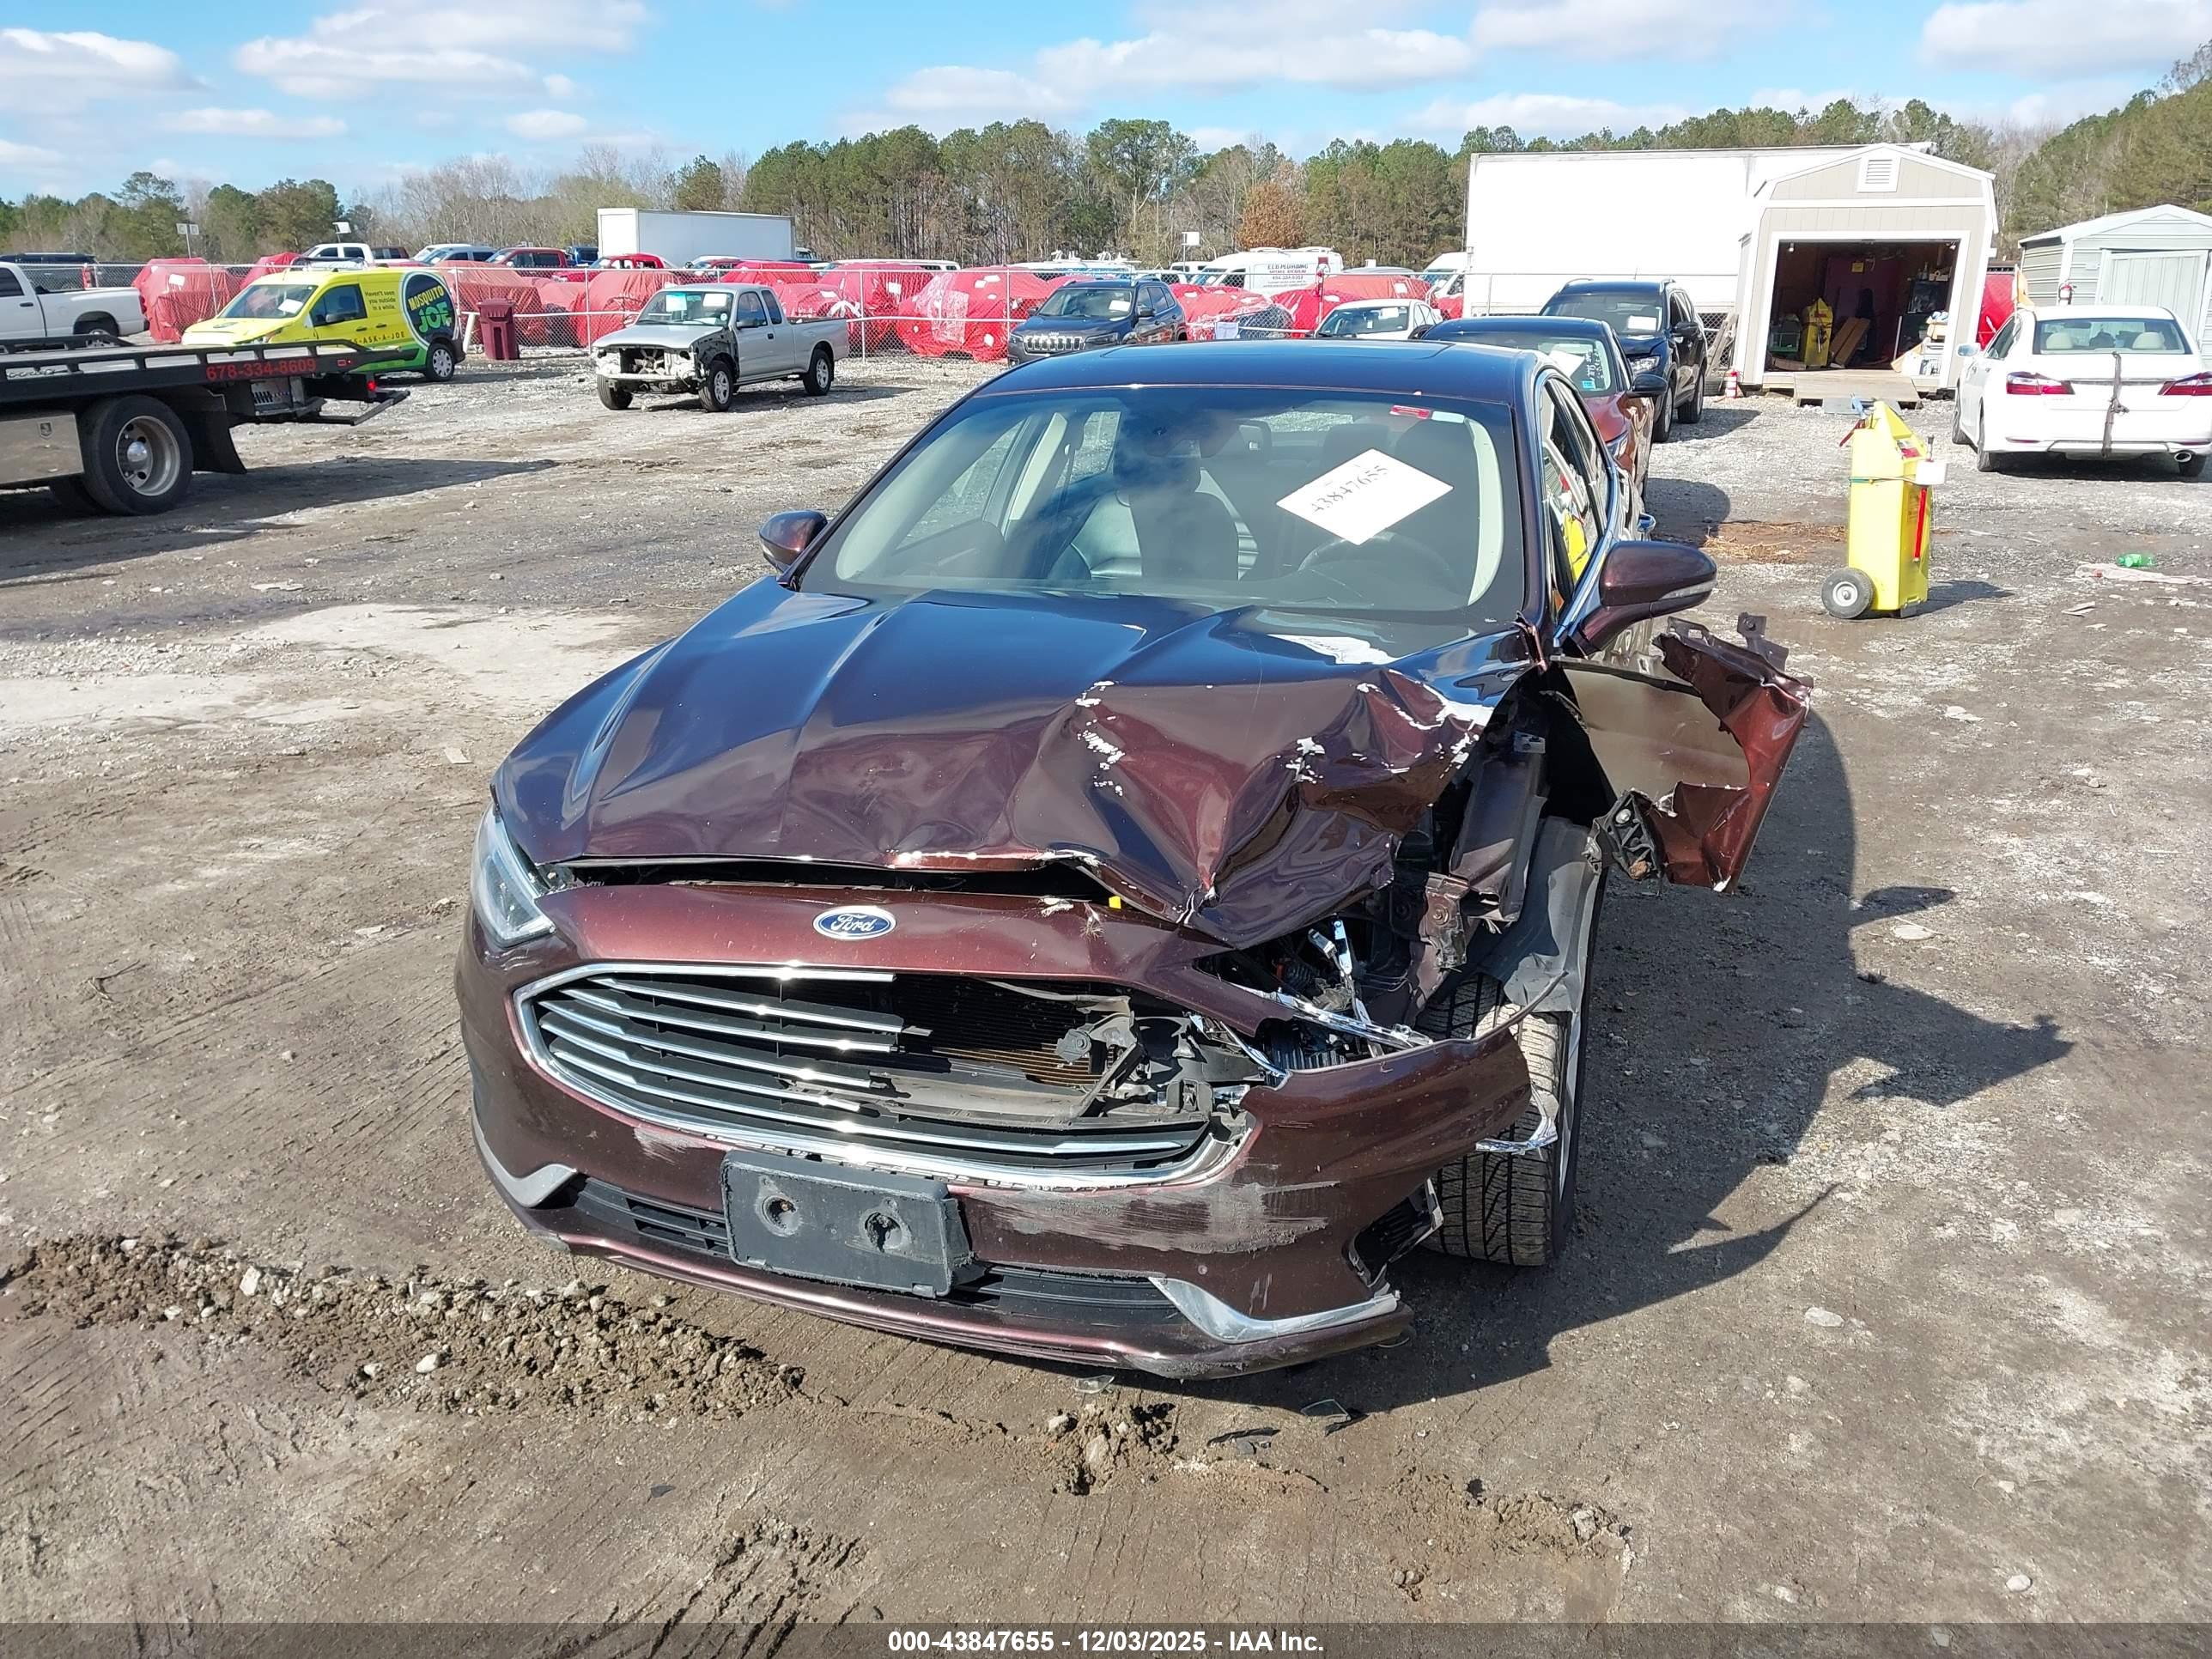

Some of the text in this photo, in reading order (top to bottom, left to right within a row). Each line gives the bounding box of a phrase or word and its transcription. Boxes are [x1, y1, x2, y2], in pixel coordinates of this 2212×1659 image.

[408, 286, 444, 311] MOSQUITO
[418, 301, 449, 332] JOE
[206, 359, 316, 381] 678-334-8609
[1311, 465, 1388, 512] 43847655
[830, 913, 878, 932] Ford
